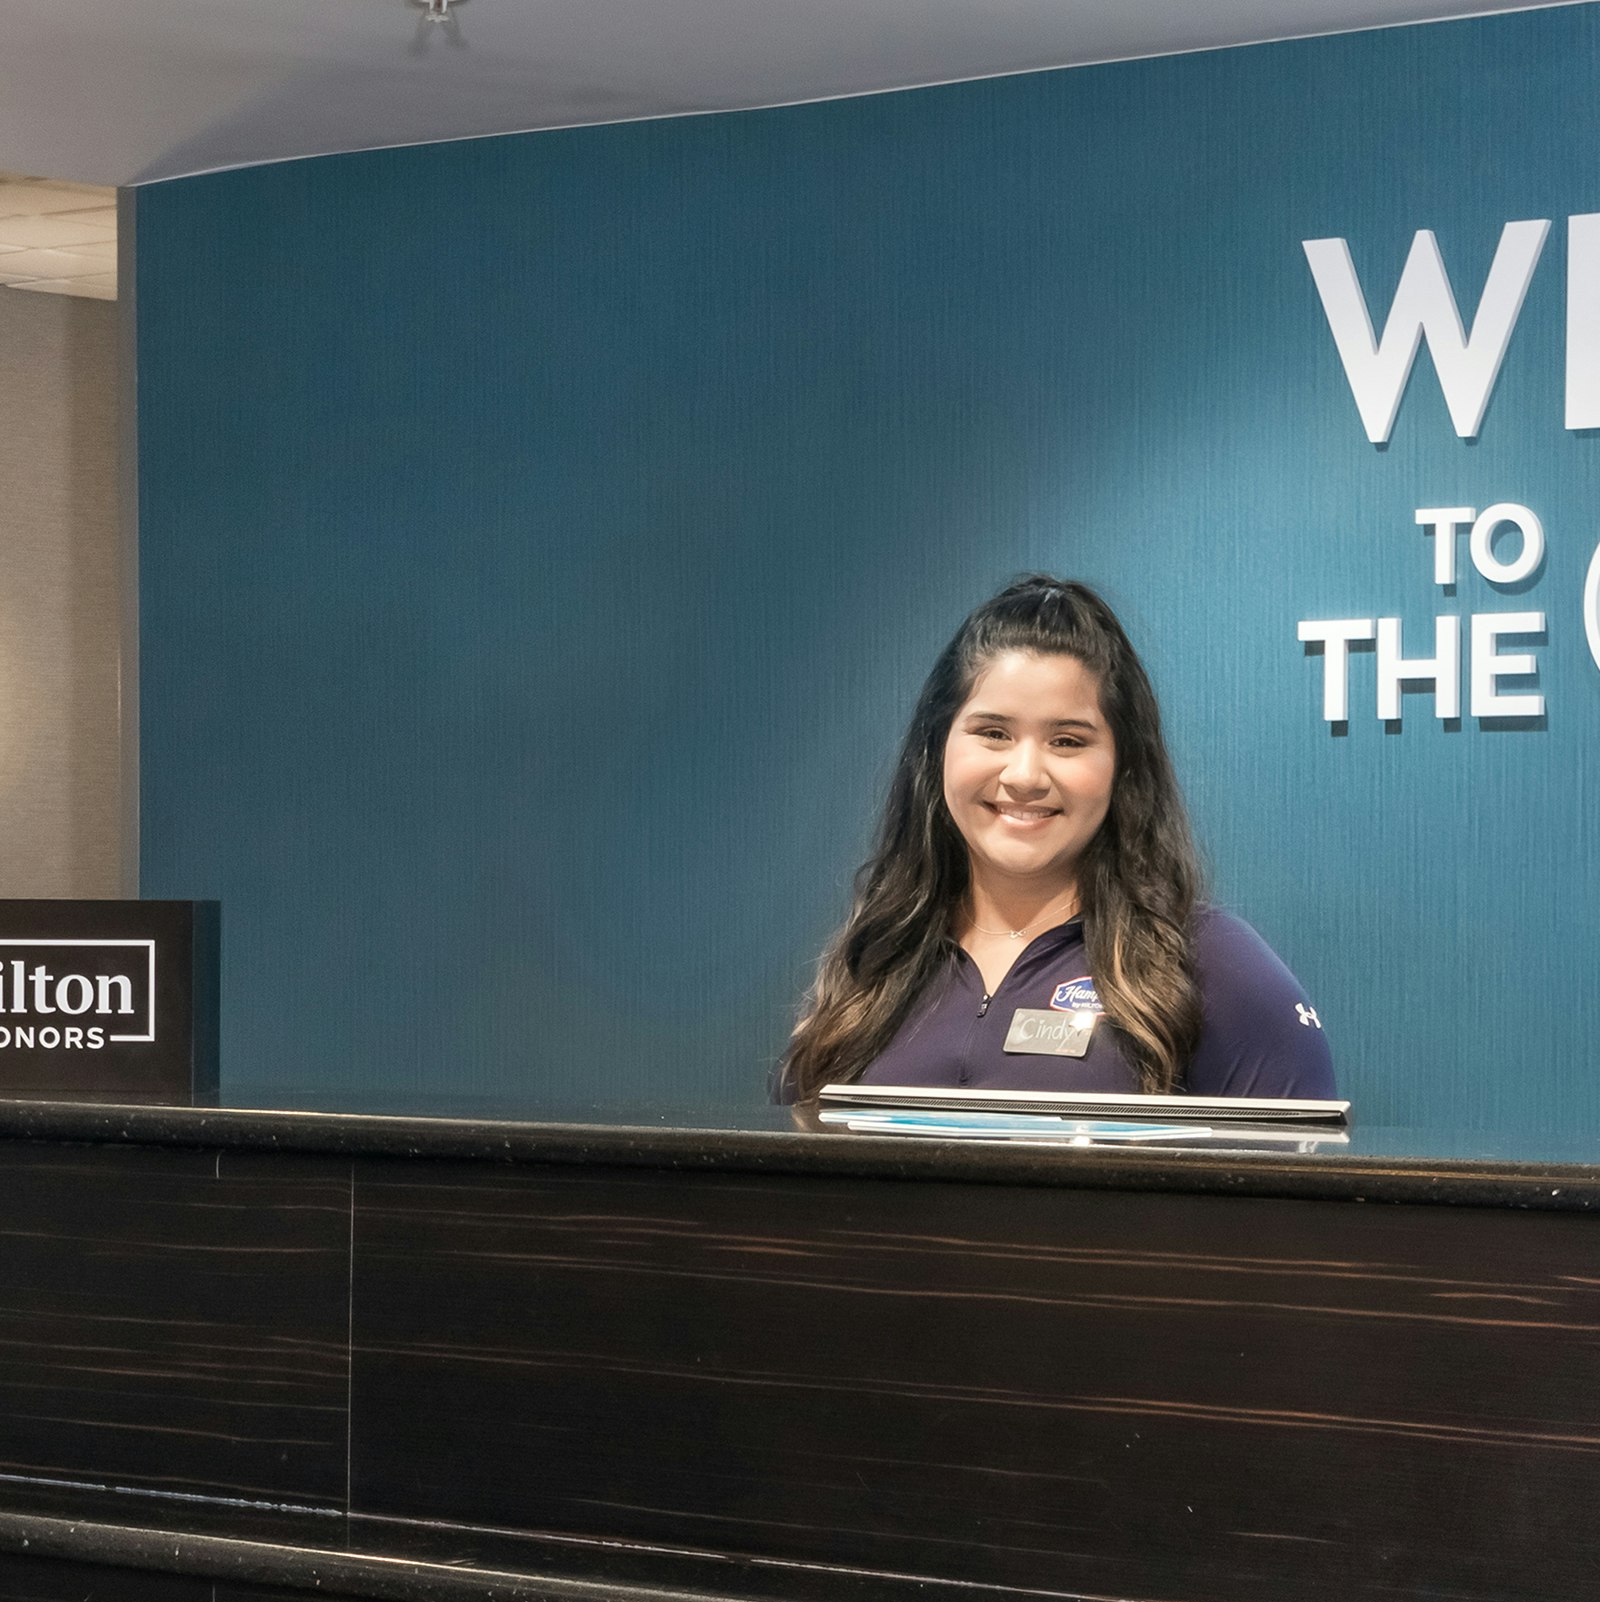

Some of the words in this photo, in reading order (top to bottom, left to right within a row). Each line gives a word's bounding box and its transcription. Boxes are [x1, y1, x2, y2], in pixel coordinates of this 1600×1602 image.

[1414, 502, 1545, 587] TO
[1297, 611, 1546, 722] THE
[1021, 1018, 1075, 1048] Cindy
